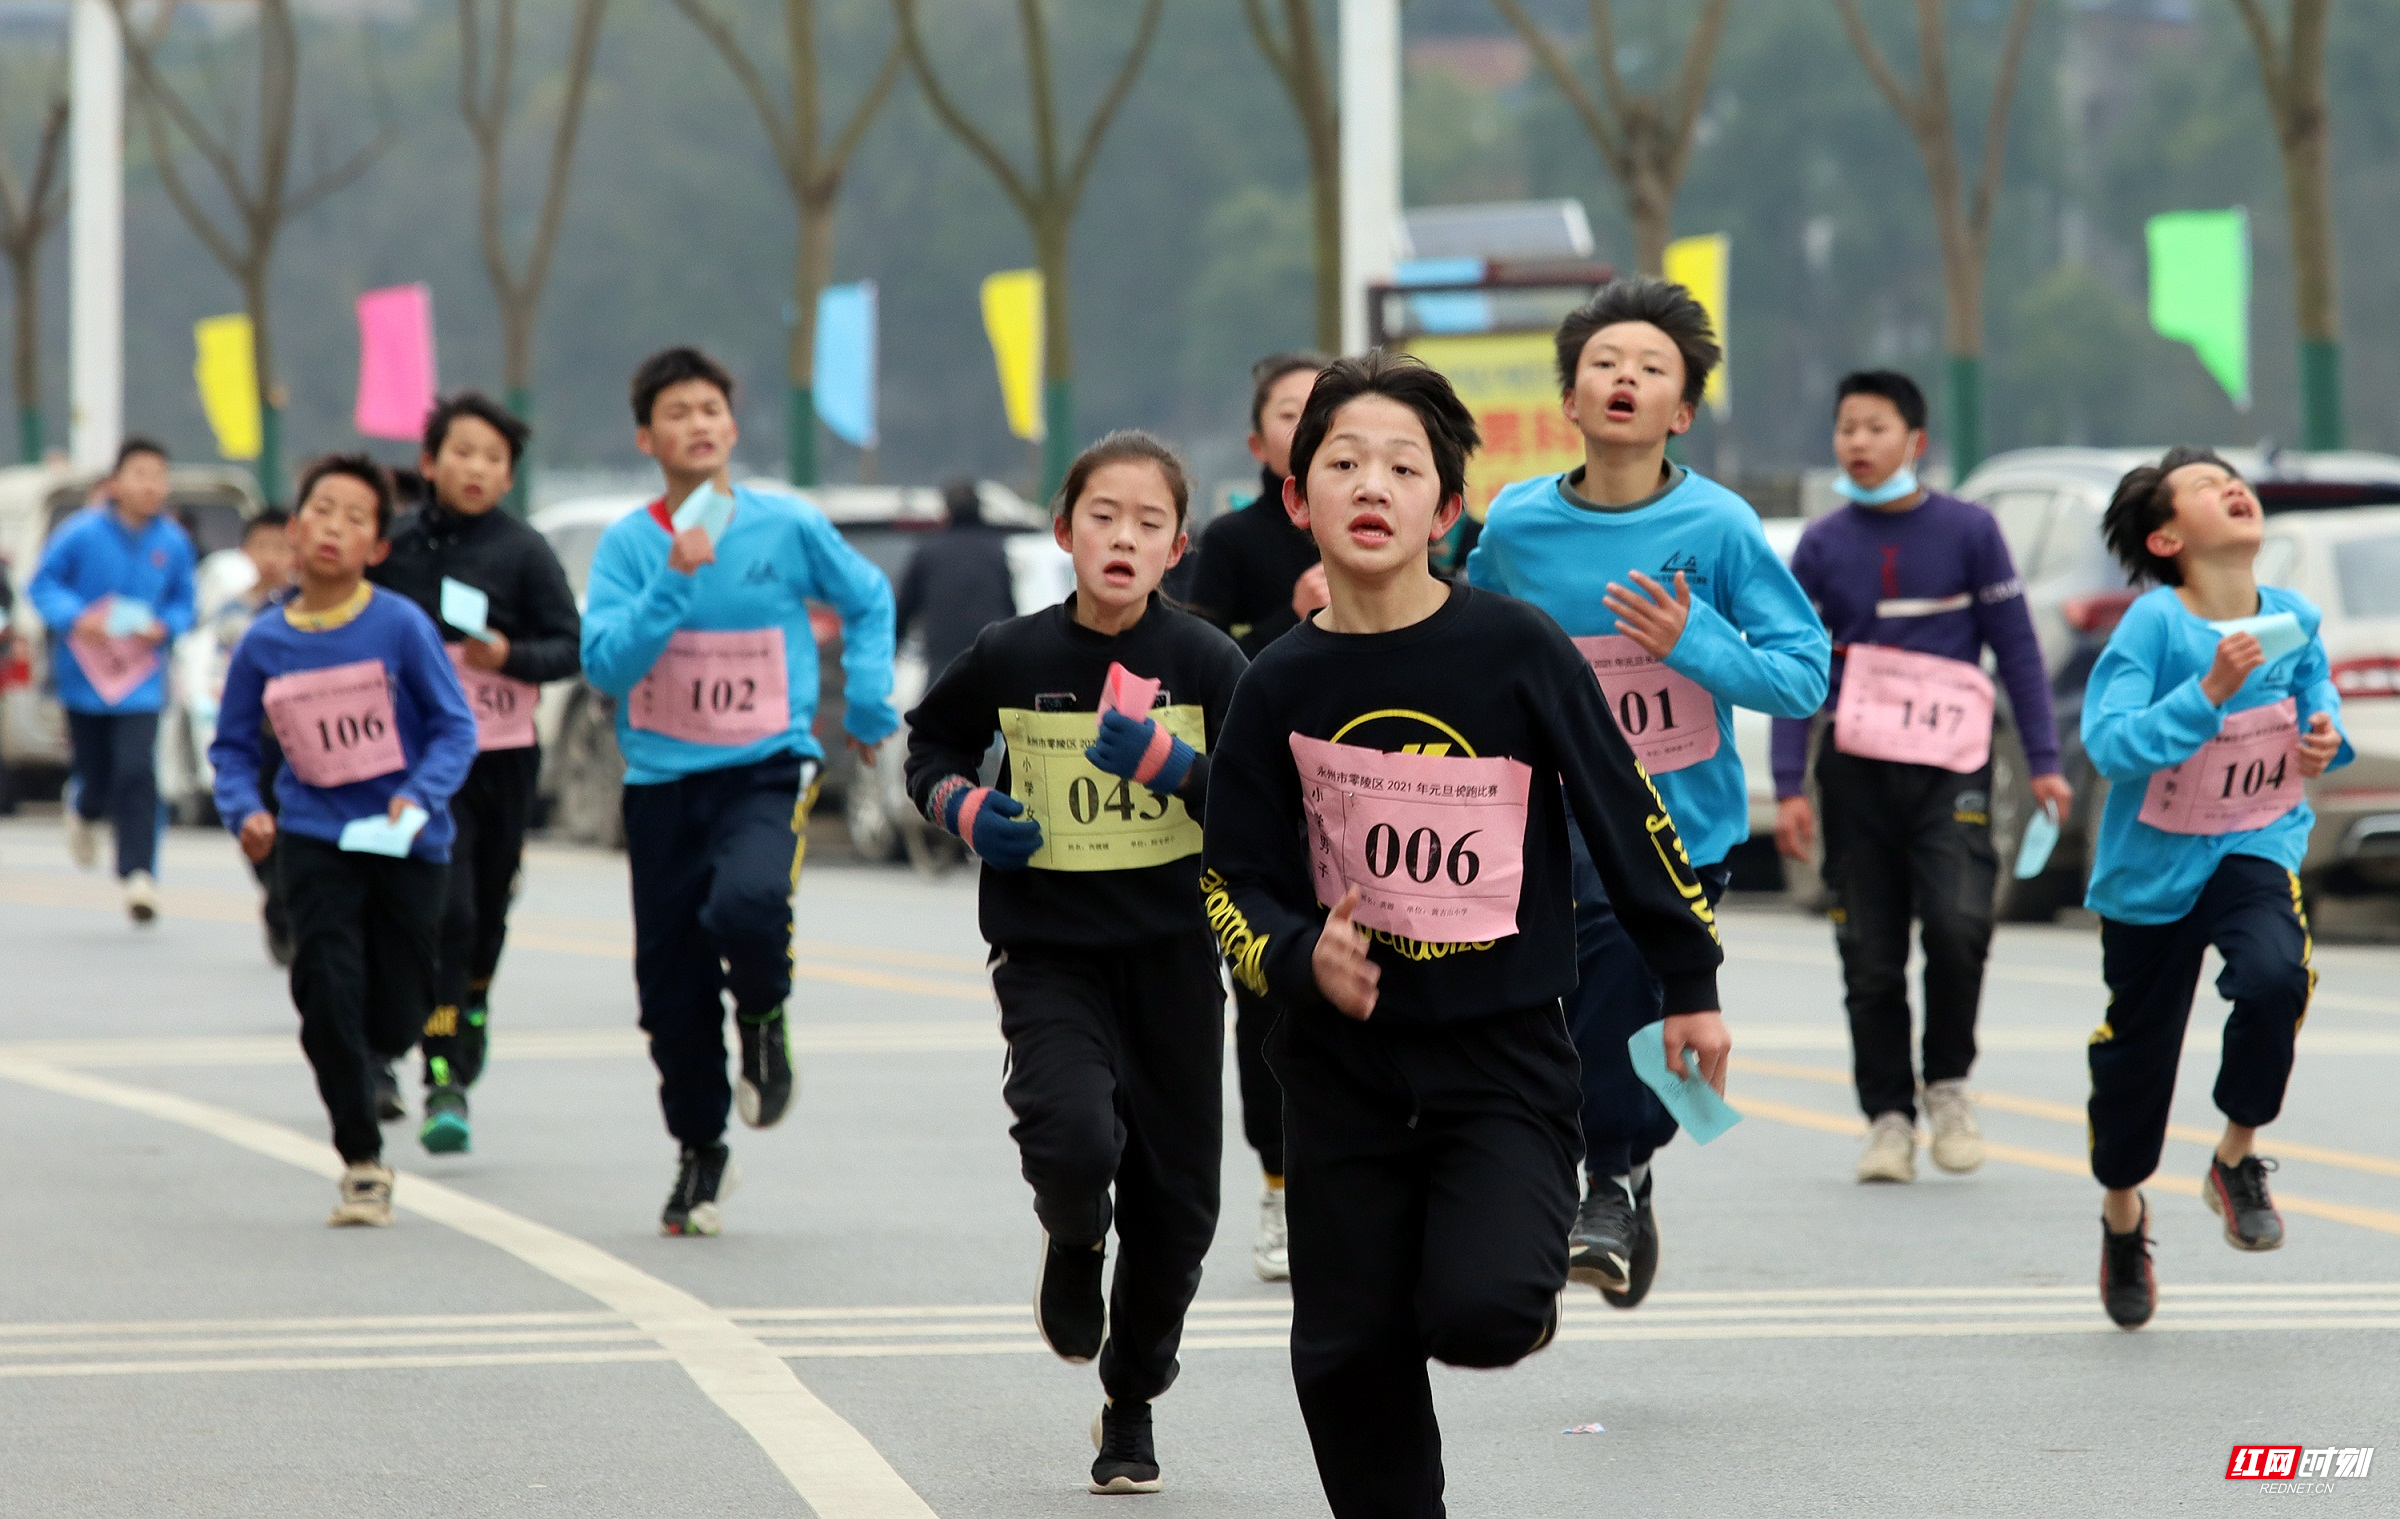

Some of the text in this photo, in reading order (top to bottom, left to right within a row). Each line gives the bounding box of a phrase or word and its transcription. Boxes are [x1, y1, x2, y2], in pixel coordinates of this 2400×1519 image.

[692, 677, 756, 713] 102
[1619, 687, 1679, 735] 01
[318, 707, 385, 752] 106
[1902, 699, 1966, 737] 147
[1316, 765, 1498, 798] 永州市零陵区 2021 年元旦长跑比赛
[2220, 753, 2288, 799] 104
[1364, 822, 1484, 886] 006
